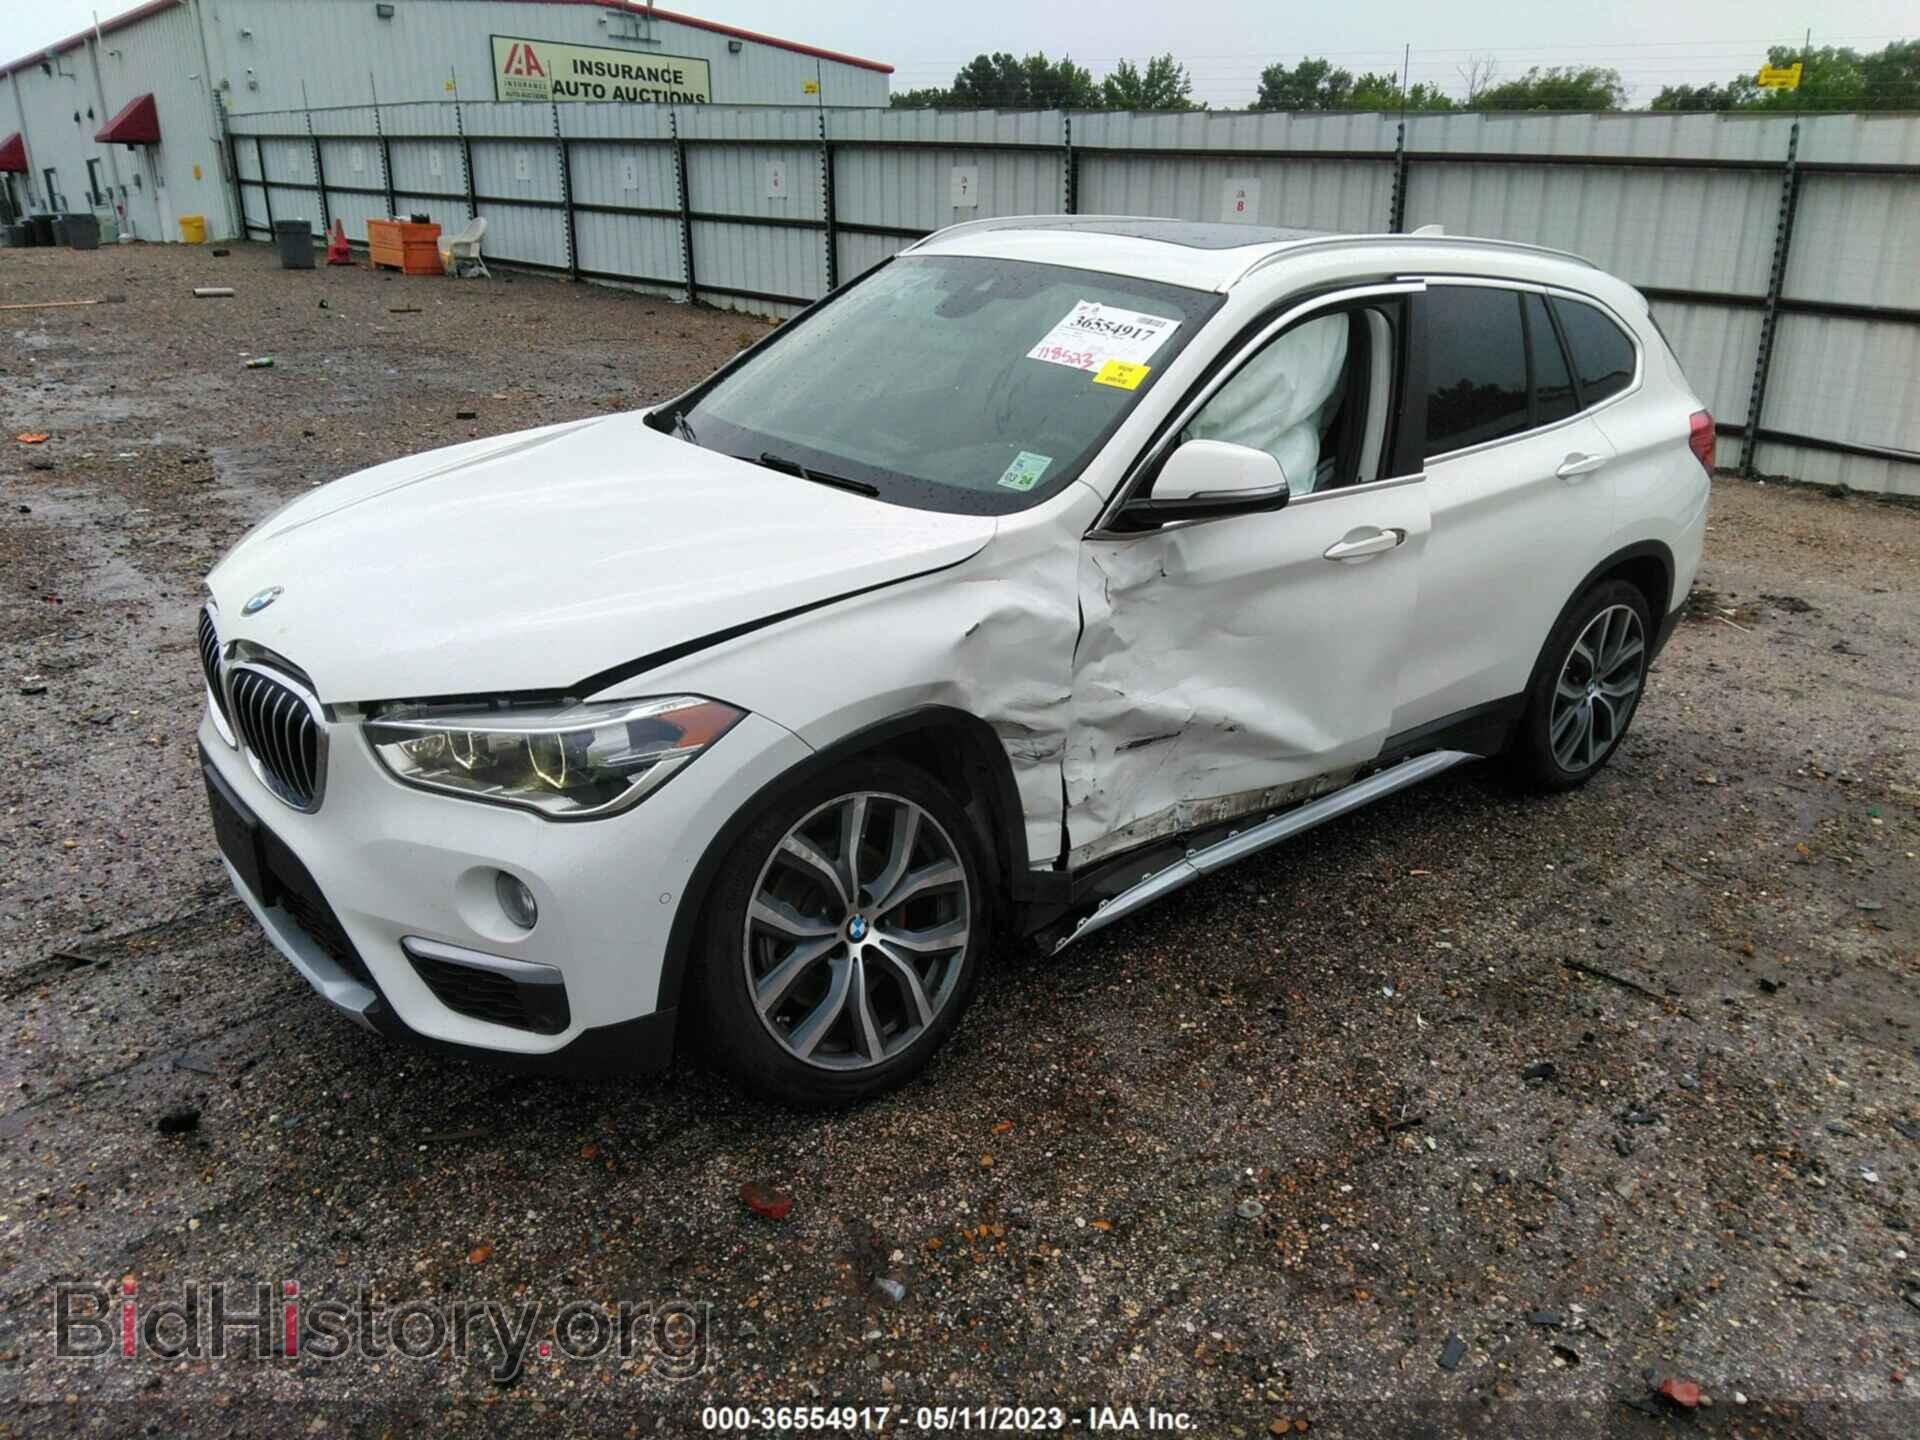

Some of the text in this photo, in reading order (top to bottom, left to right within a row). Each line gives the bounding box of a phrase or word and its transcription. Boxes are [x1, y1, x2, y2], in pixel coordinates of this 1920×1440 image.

[572, 58, 684, 85] INSURANCE
[552, 80, 705, 104] AUTO AUCTIONS
[1236, 200, 1245, 213] 8
[1070, 315, 1156, 341] 36554917
